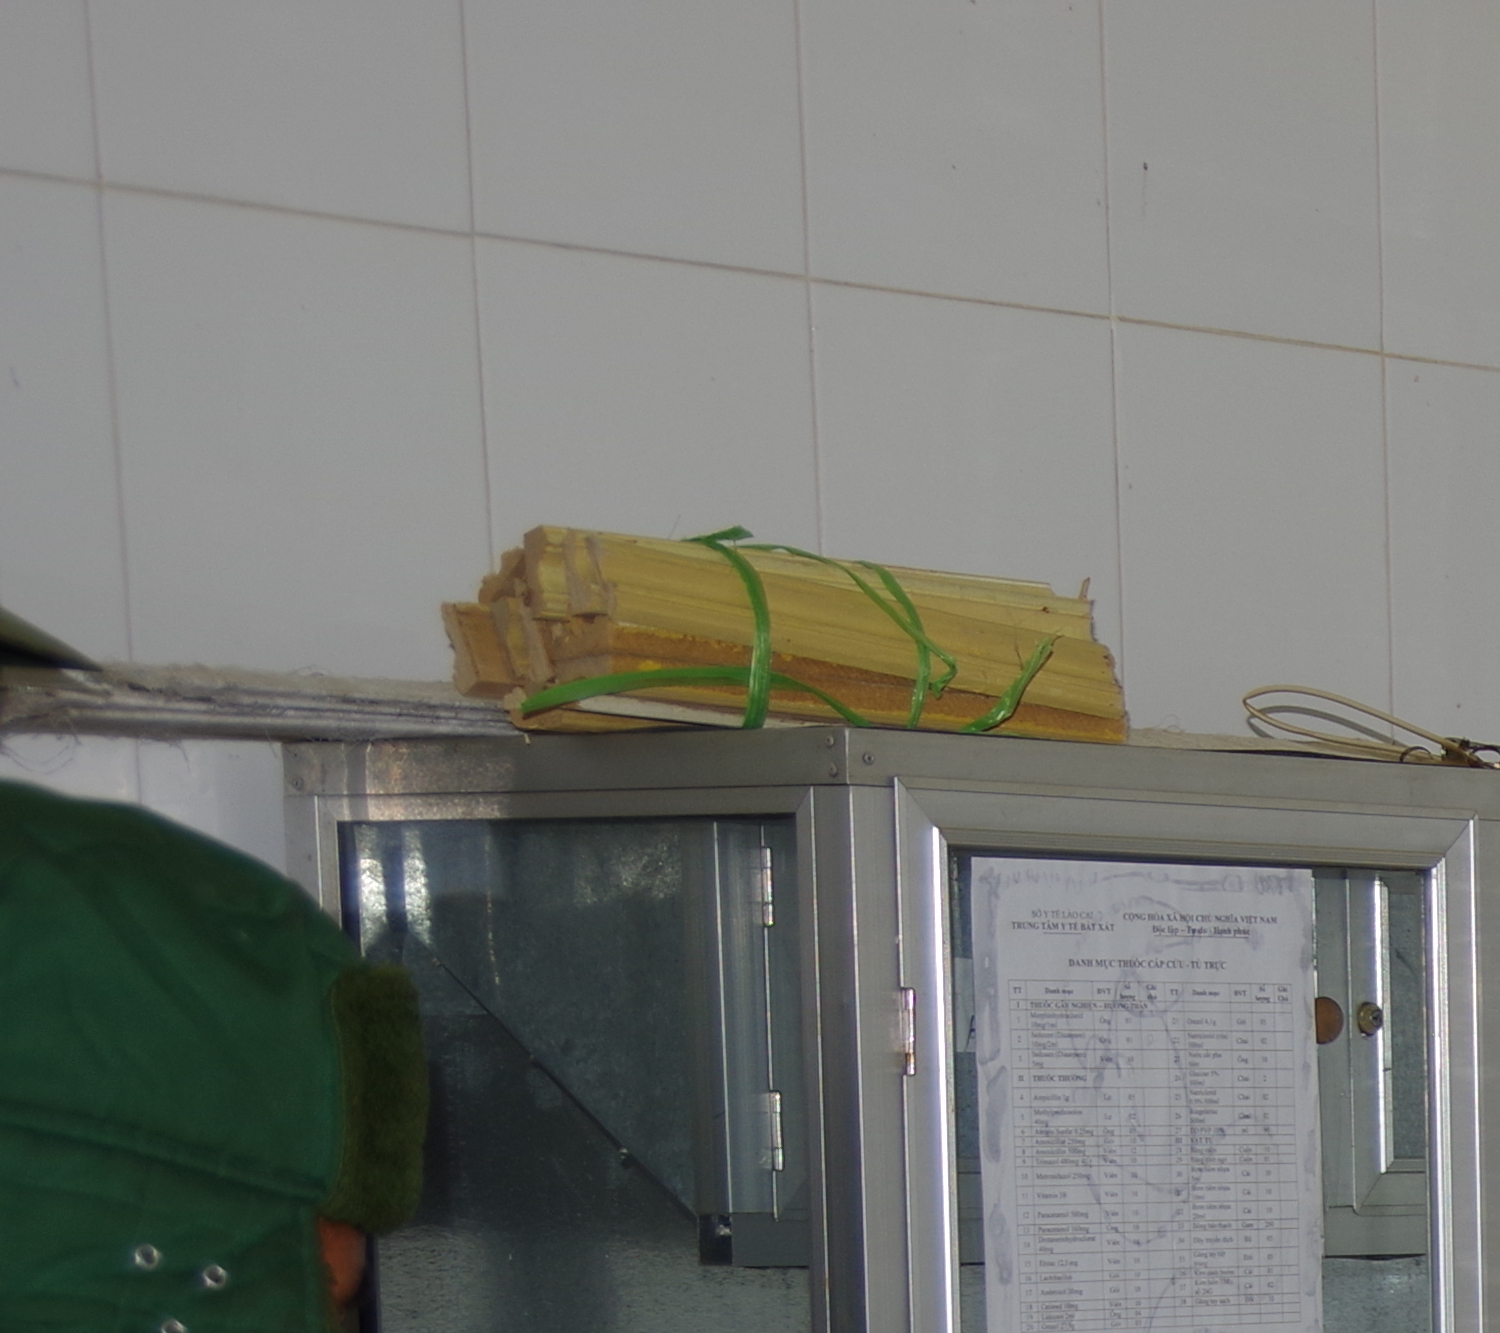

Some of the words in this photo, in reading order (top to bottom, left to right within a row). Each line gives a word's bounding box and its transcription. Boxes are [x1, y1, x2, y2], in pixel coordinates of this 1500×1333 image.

[1123, 912, 1146, 923] CỘNG
[1240, 914, 1258, 925] VIỆT
[1259, 916, 1278, 924] NAM
[1011, 922, 1040, 931] TRUNG
[1040, 920, 1060, 931] TÂM
[1068, 959, 1093, 968] DANH
[1094, 959, 1116, 970] MỤC
[1116, 956, 1148, 968] THUỐC
